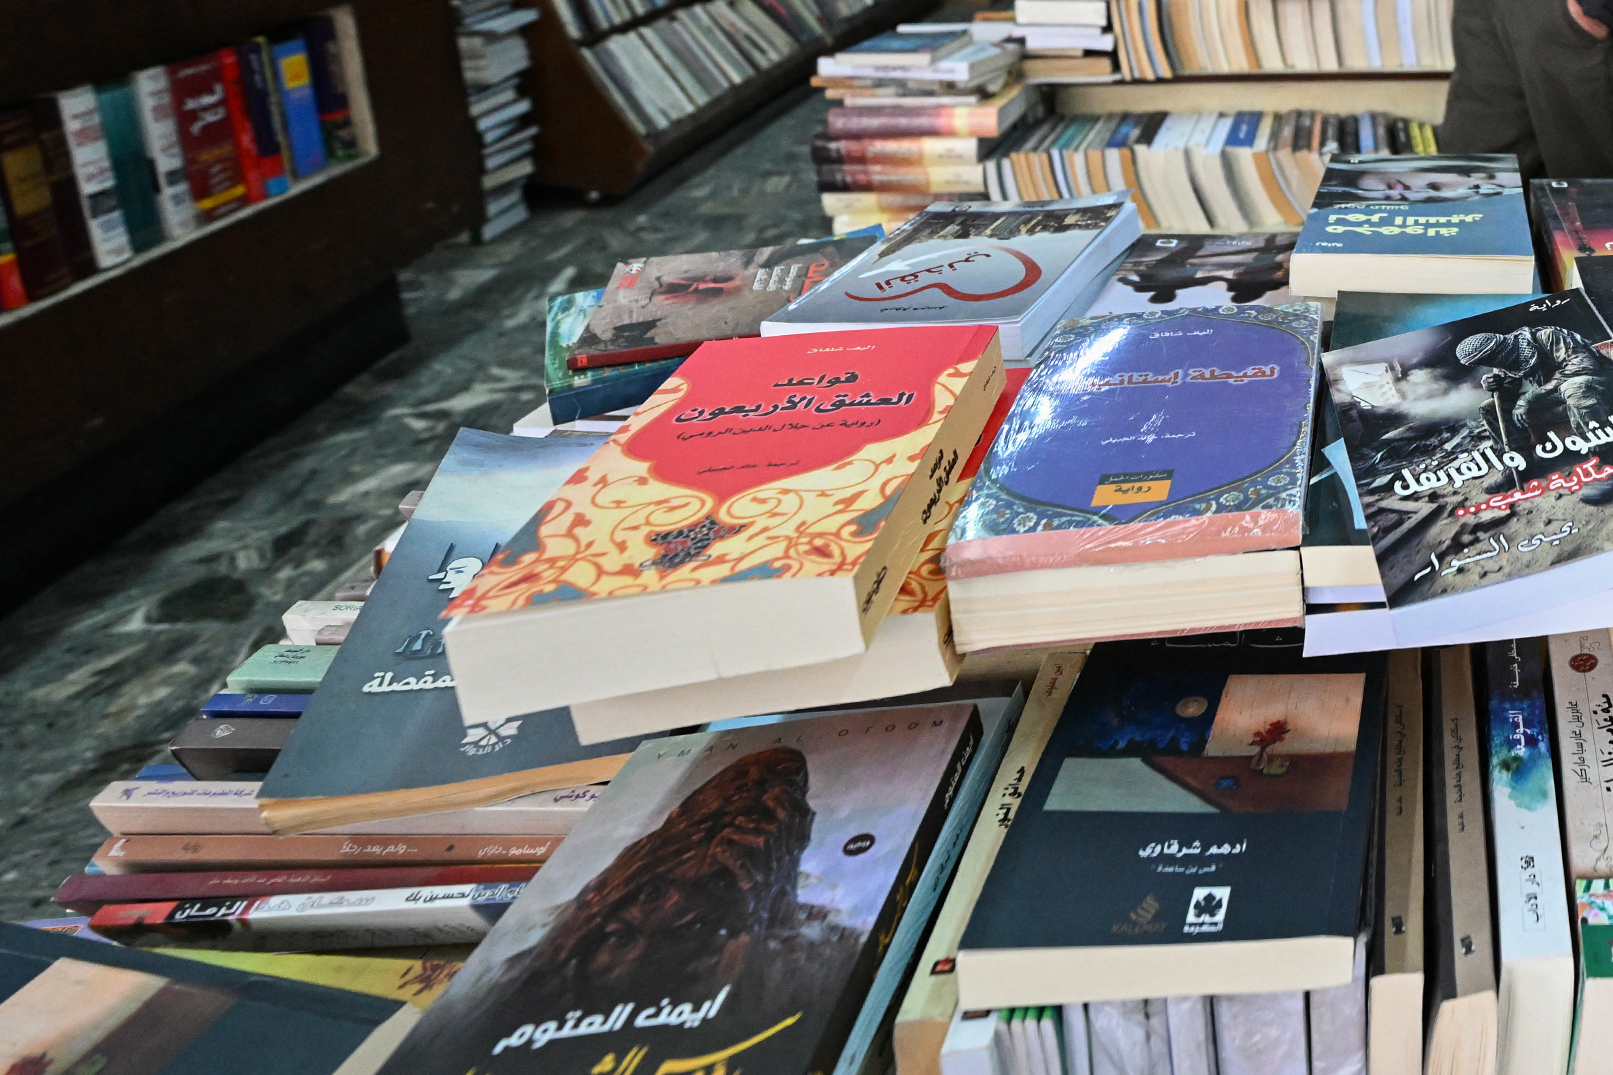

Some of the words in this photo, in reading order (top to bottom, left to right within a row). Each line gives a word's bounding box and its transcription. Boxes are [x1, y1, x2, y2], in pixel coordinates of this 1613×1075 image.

[1328, 213, 1388, 226] نهر
[1394, 213, 1484, 226] السين
[1324, 225, 1461, 237] مجهولة
[875, 251, 992, 294] أنقذني
[1529, 297, 1571, 312] رواية
[772, 371, 860, 389] قواعد
[1188, 365, 1278, 384] لقيطة
[674, 394, 815, 424] الأربعون
[813, 390, 916, 414] العشق
[1392, 446, 1528, 499] والقرنفل
[1113, 484, 1152, 495] رواية
[1517, 521, 1580, 555] يحيى
[1413, 533, 1509, 582] السنوار
[1508, 710, 1525, 756] القوقعة
[554, 789, 599, 802] وكوشي
[363, 845, 383, 855] يعد
[507, 841, 550, 856] أوسامو
[1138, 840, 1202, 857] شرقاوي
[1205, 838, 1247, 855] أدهم
[174, 899, 250, 920] الزمان
[491, 1001, 636, 1056] العتوم
